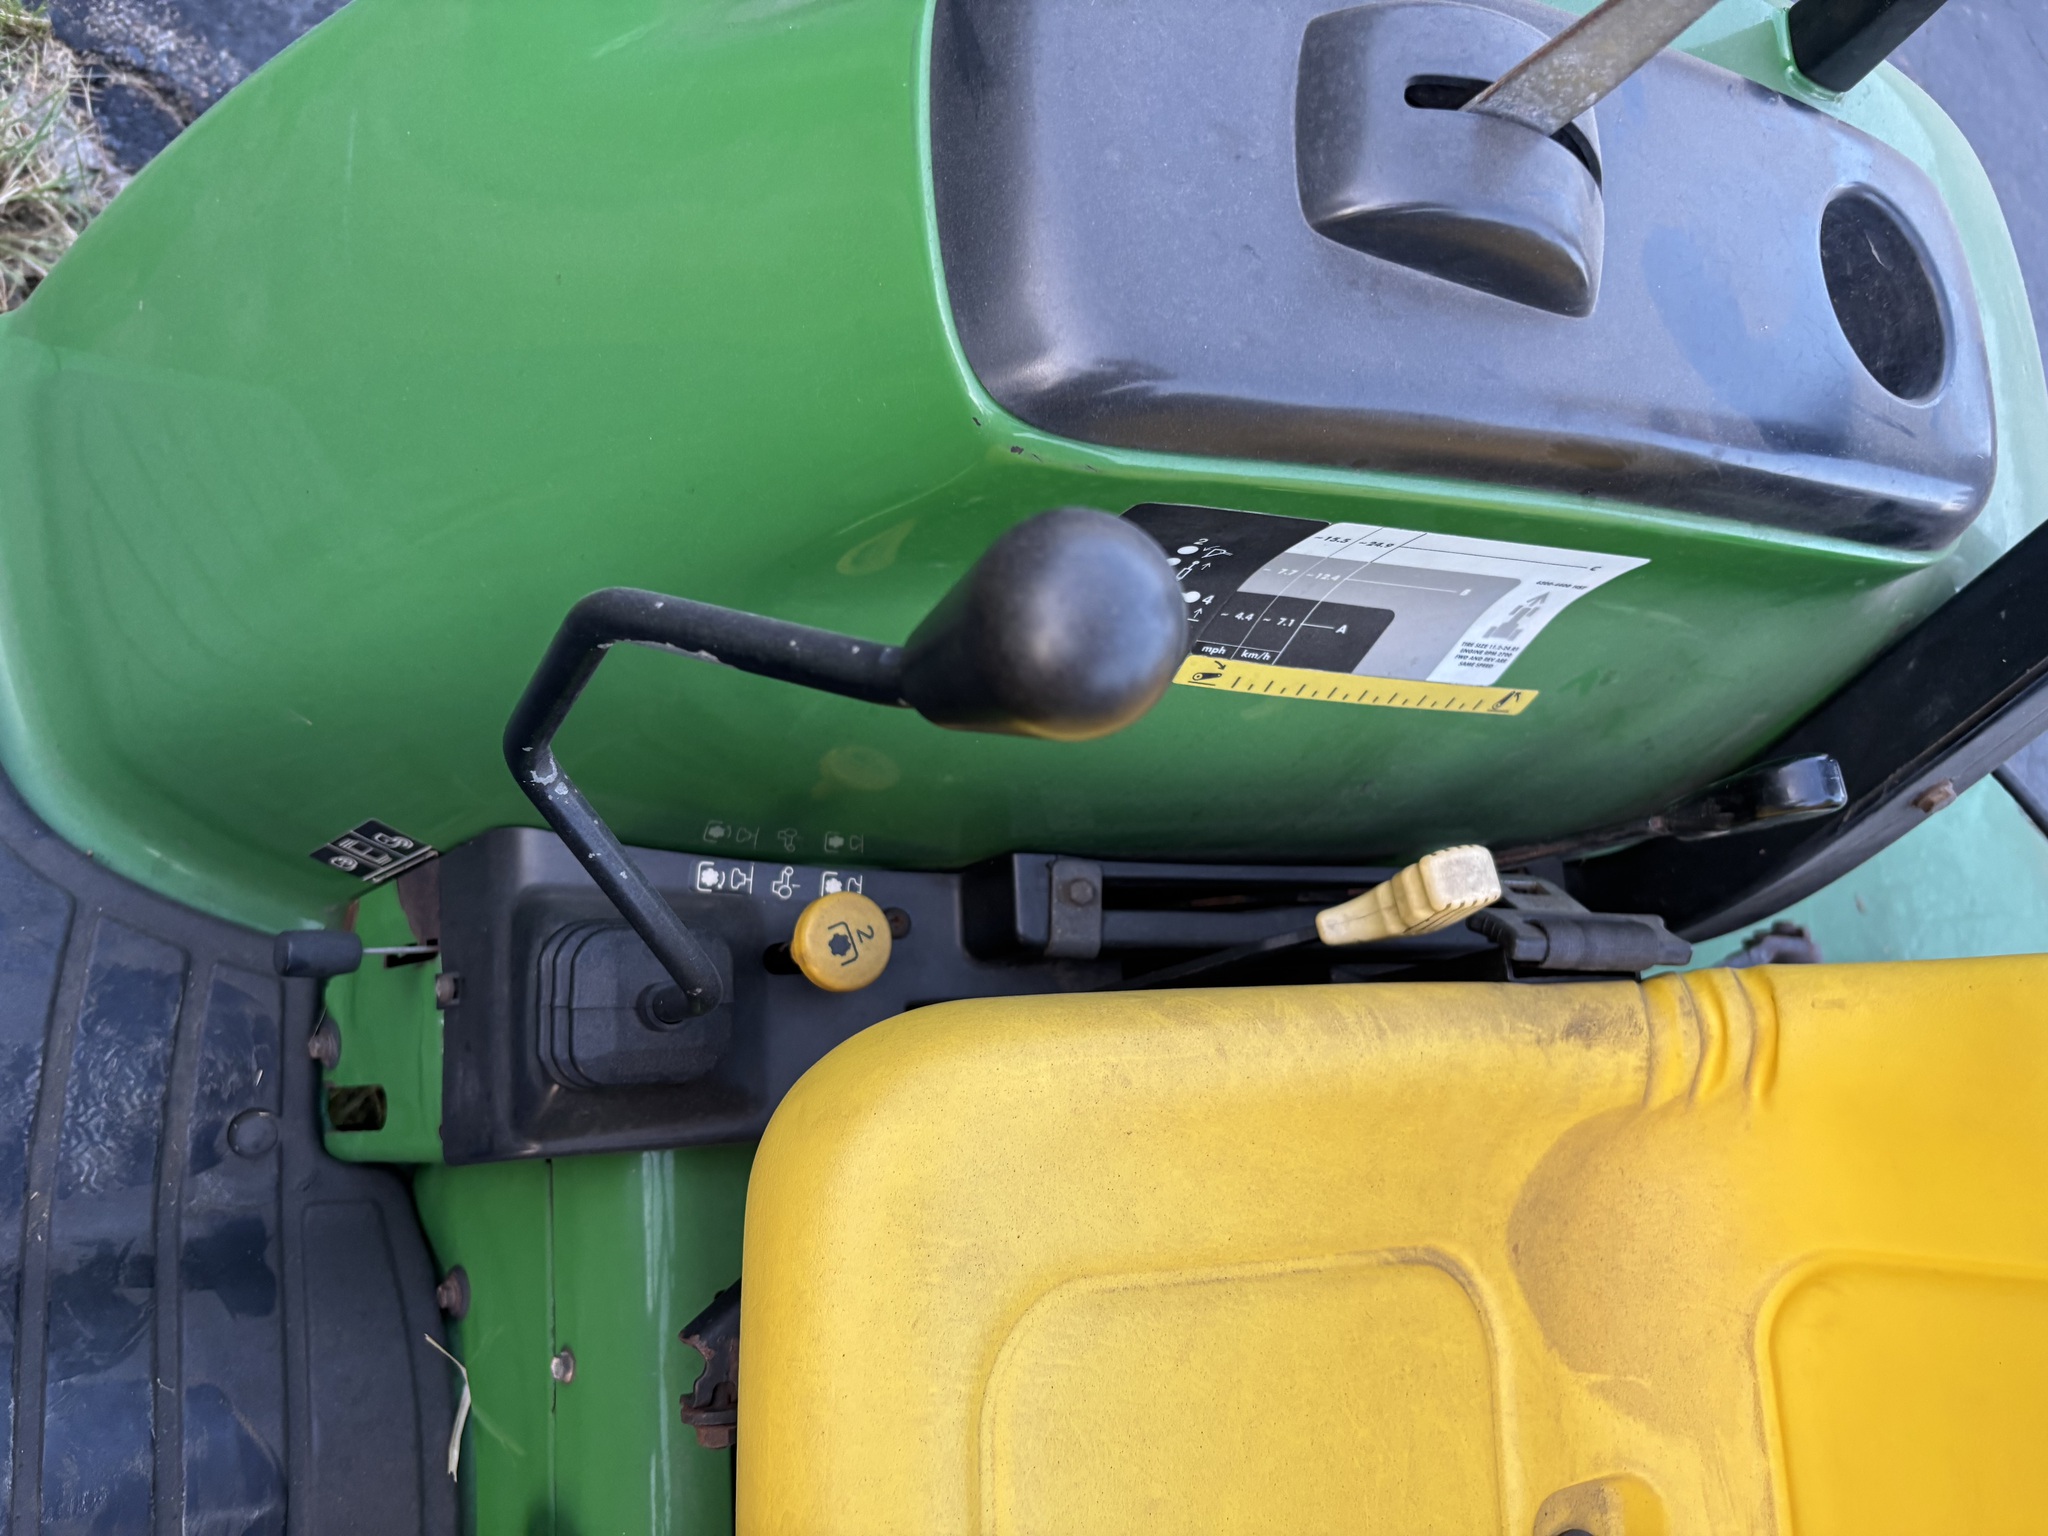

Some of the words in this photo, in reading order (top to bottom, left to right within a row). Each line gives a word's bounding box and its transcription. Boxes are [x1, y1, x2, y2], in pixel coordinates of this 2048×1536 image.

[1202, 595, 1215, 605] 4
[1234, 612, 1255, 621] 4.4
[1277, 617, 1296, 627] 7.1
[1335, 624, 1348, 635] A
[1201, 645, 1227, 655] mph
[1240, 649, 1271, 661] km/h
[856, 924, 875, 944] 2
